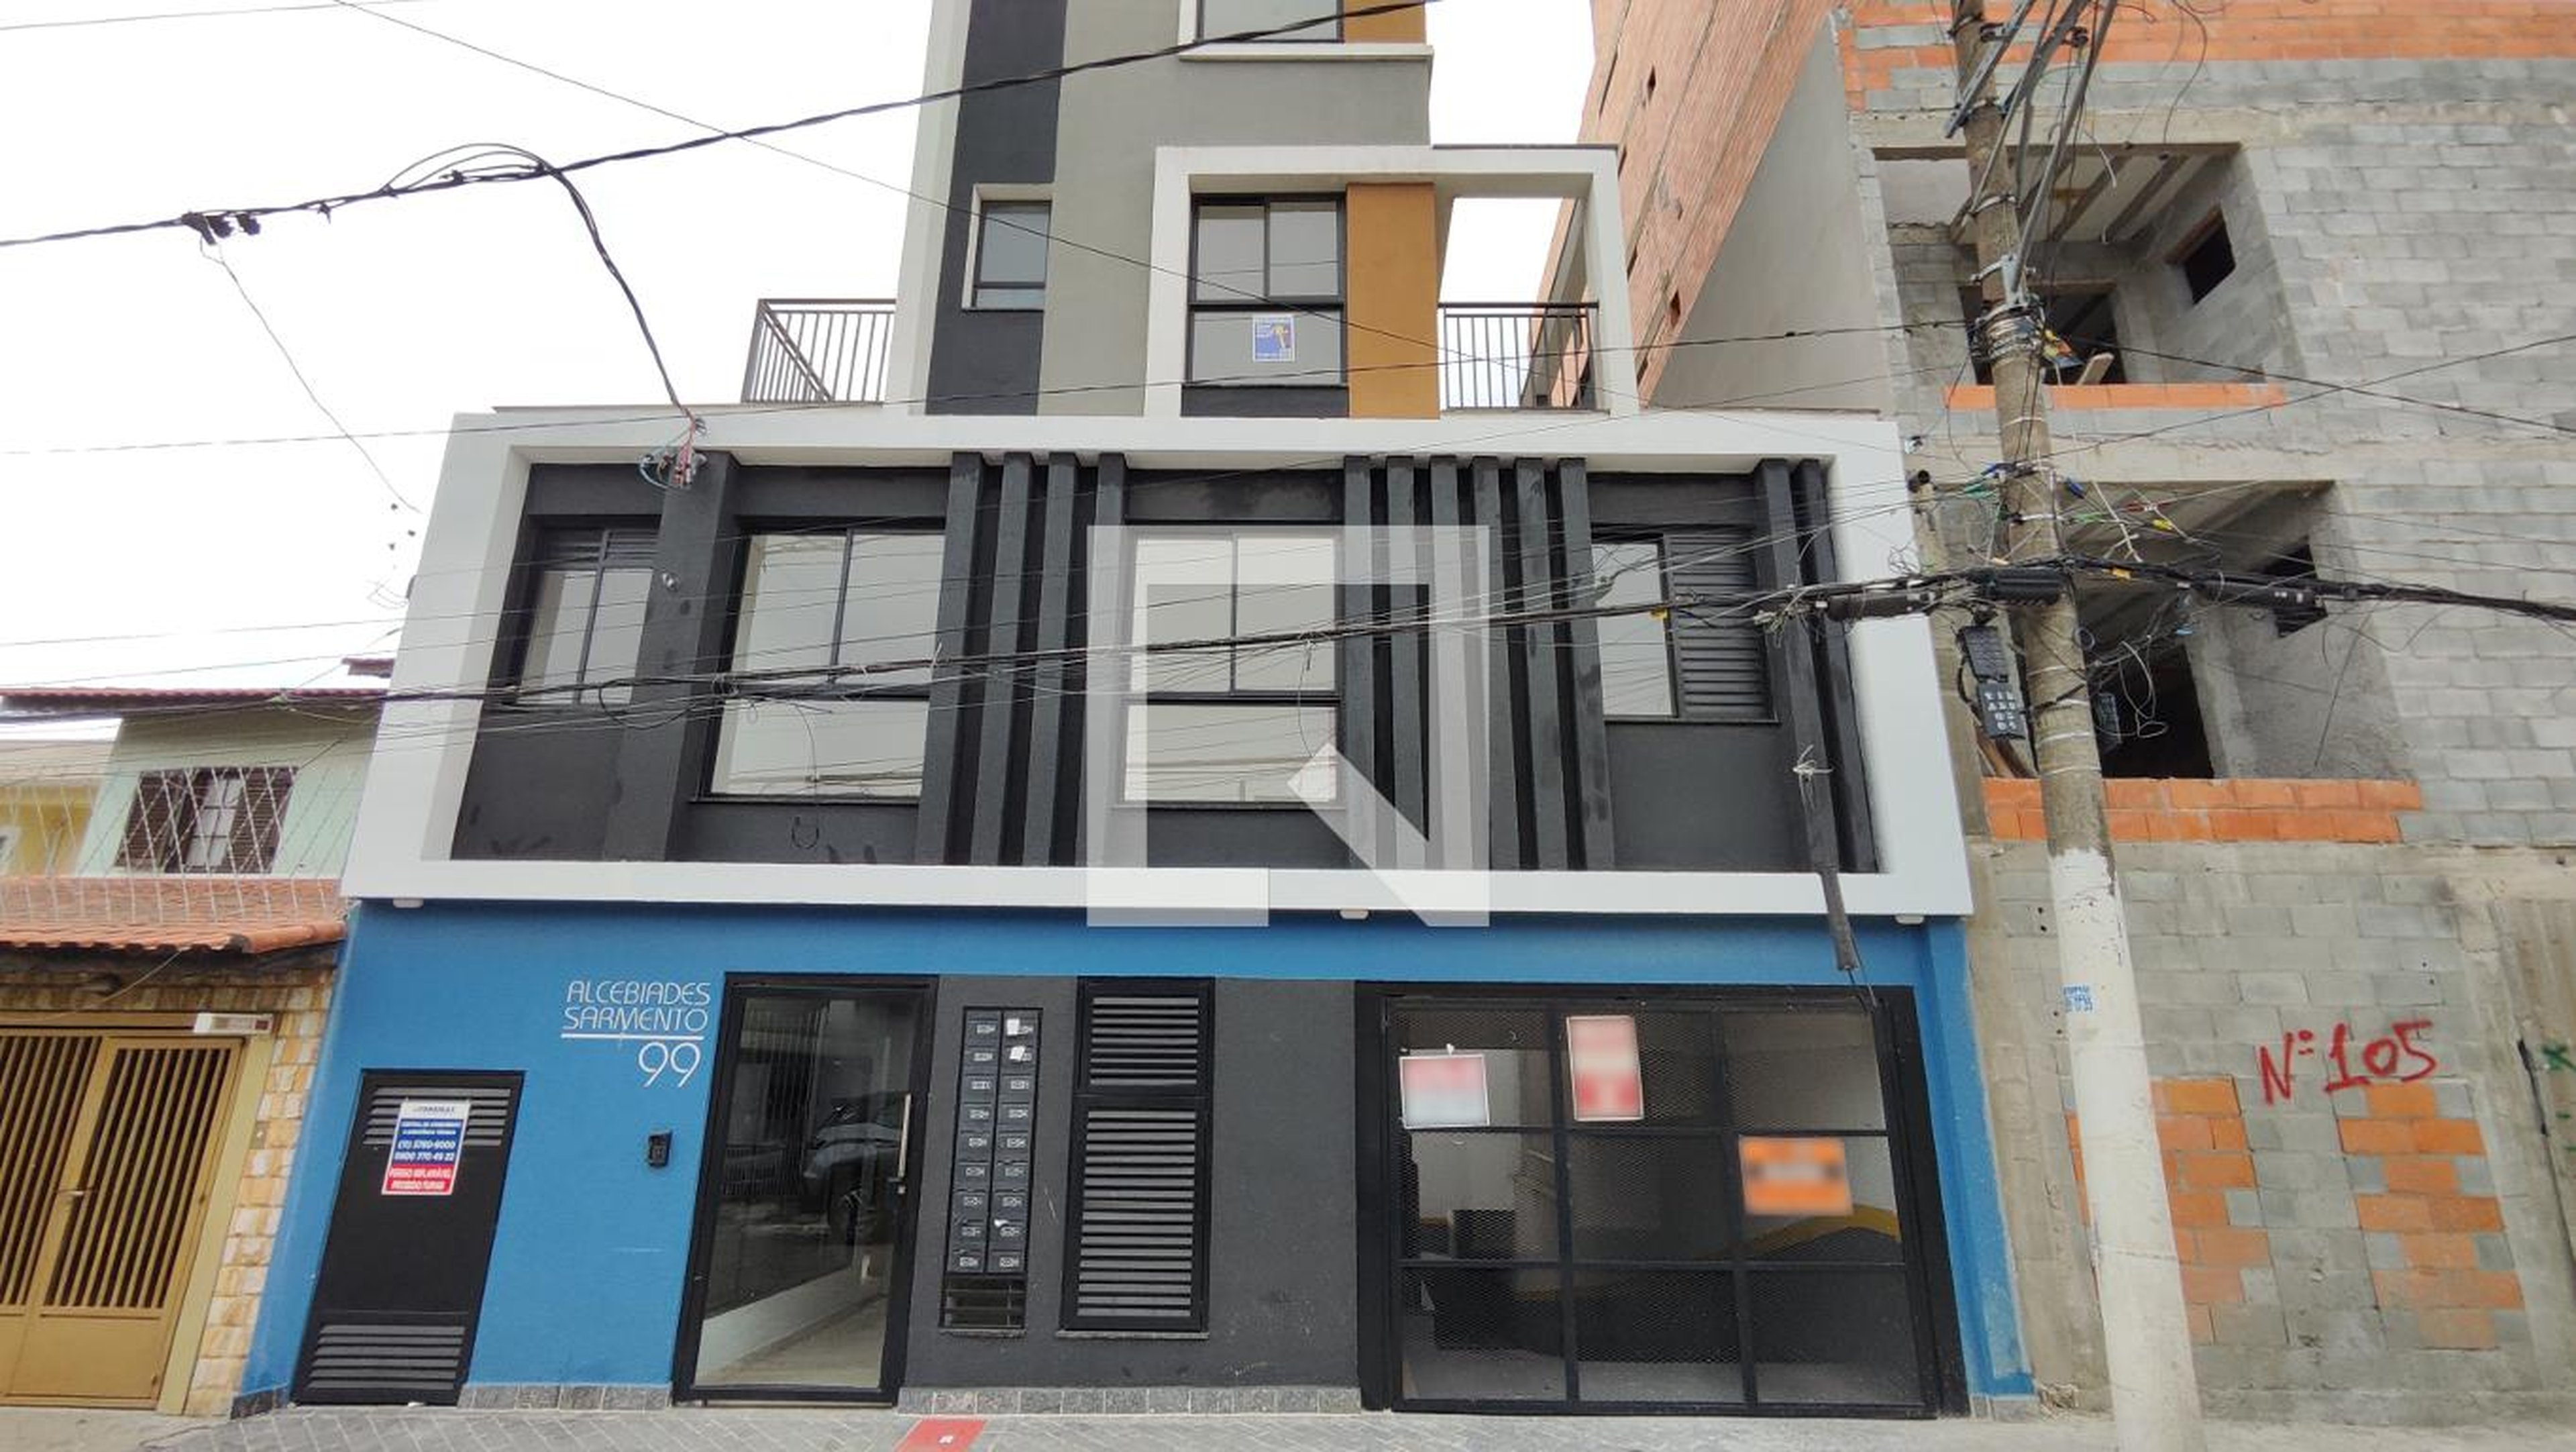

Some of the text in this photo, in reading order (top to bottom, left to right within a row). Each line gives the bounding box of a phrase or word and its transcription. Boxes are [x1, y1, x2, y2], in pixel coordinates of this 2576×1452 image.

[566, 980, 711, 1006] ALCEBIADES
[562, 1006, 708, 1032] SARMENTO
[638, 1041, 701, 1088] 99
